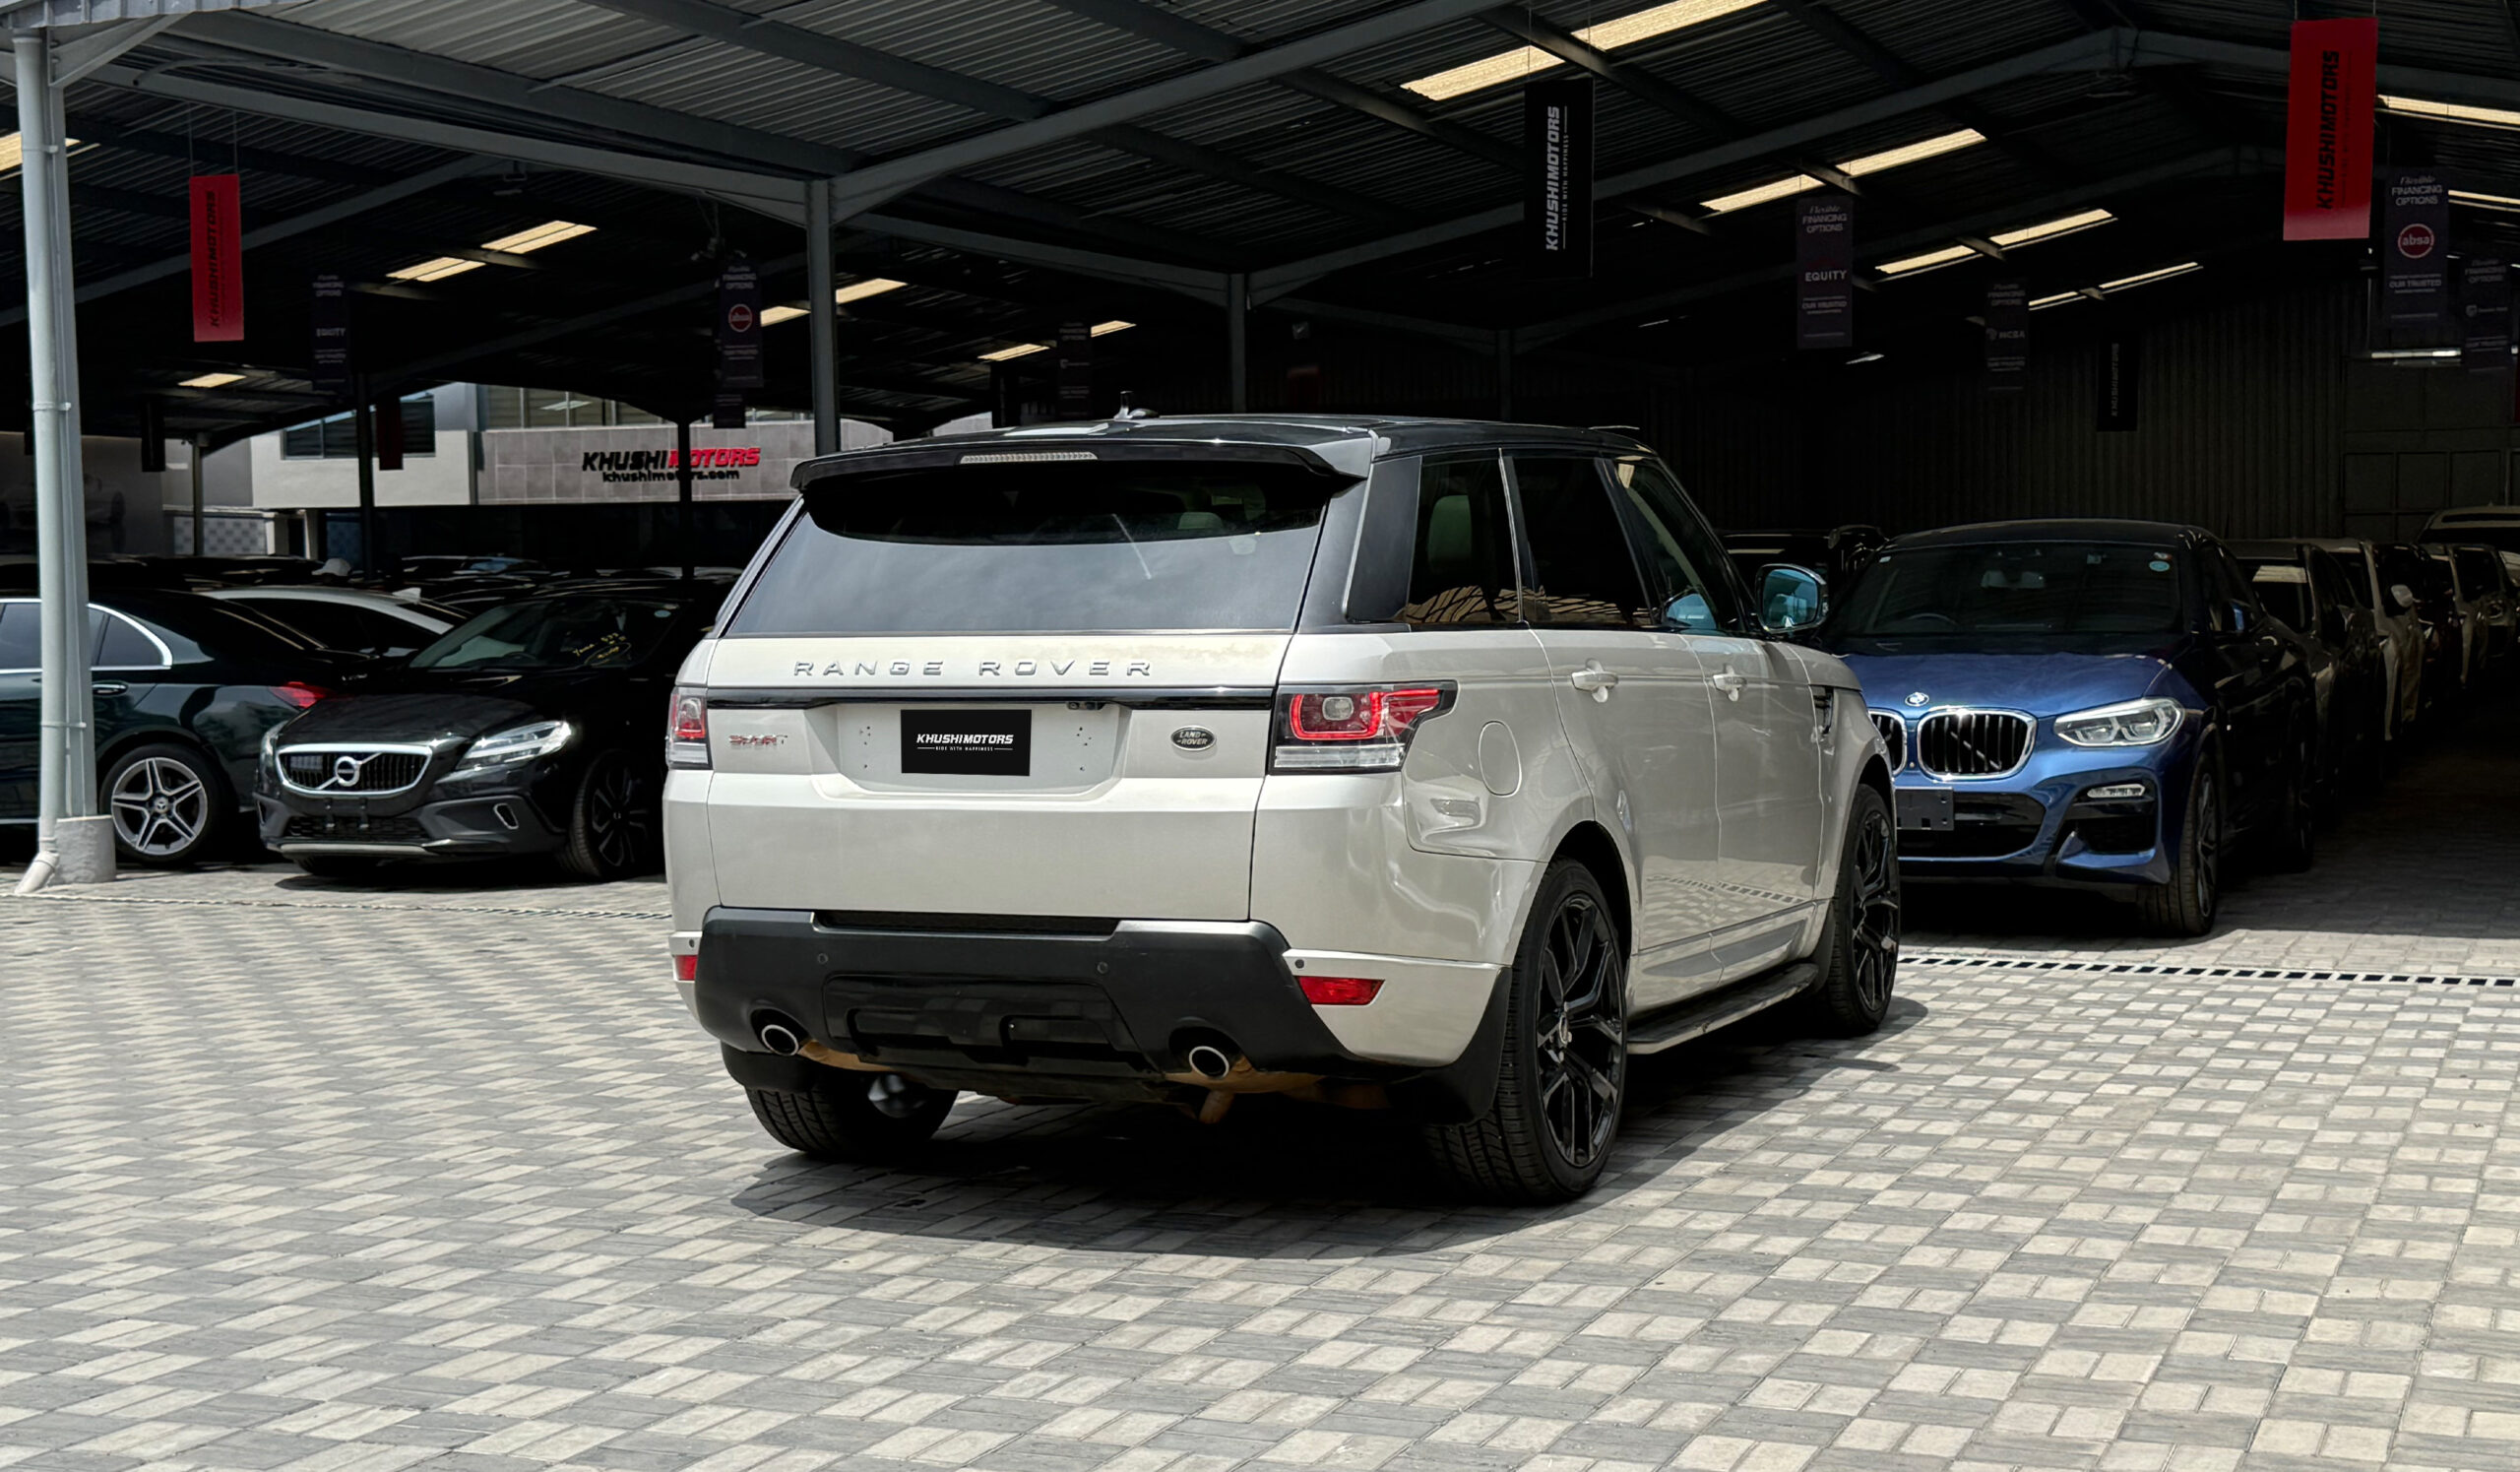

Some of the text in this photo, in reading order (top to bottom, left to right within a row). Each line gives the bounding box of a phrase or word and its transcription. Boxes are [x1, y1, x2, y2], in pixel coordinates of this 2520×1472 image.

[2315, 49, 2340, 211] KHUSHIMOTORS
[1544, 104, 1561, 252] KHUSHIMOTORS
[2391, 184, 2443, 197] FINANCING
[2395, 195, 2438, 206] OPTIONS
[1802, 213, 1848, 225] FINANCING
[1805, 223, 1844, 234] OPTIONS
[2402, 232, 2430, 247] absa
[1804, 269, 1848, 283] EQUITY
[792, 660, 1152, 677] RANGE ROVER
[916, 733, 1015, 745] KHUSHIMOTORS
